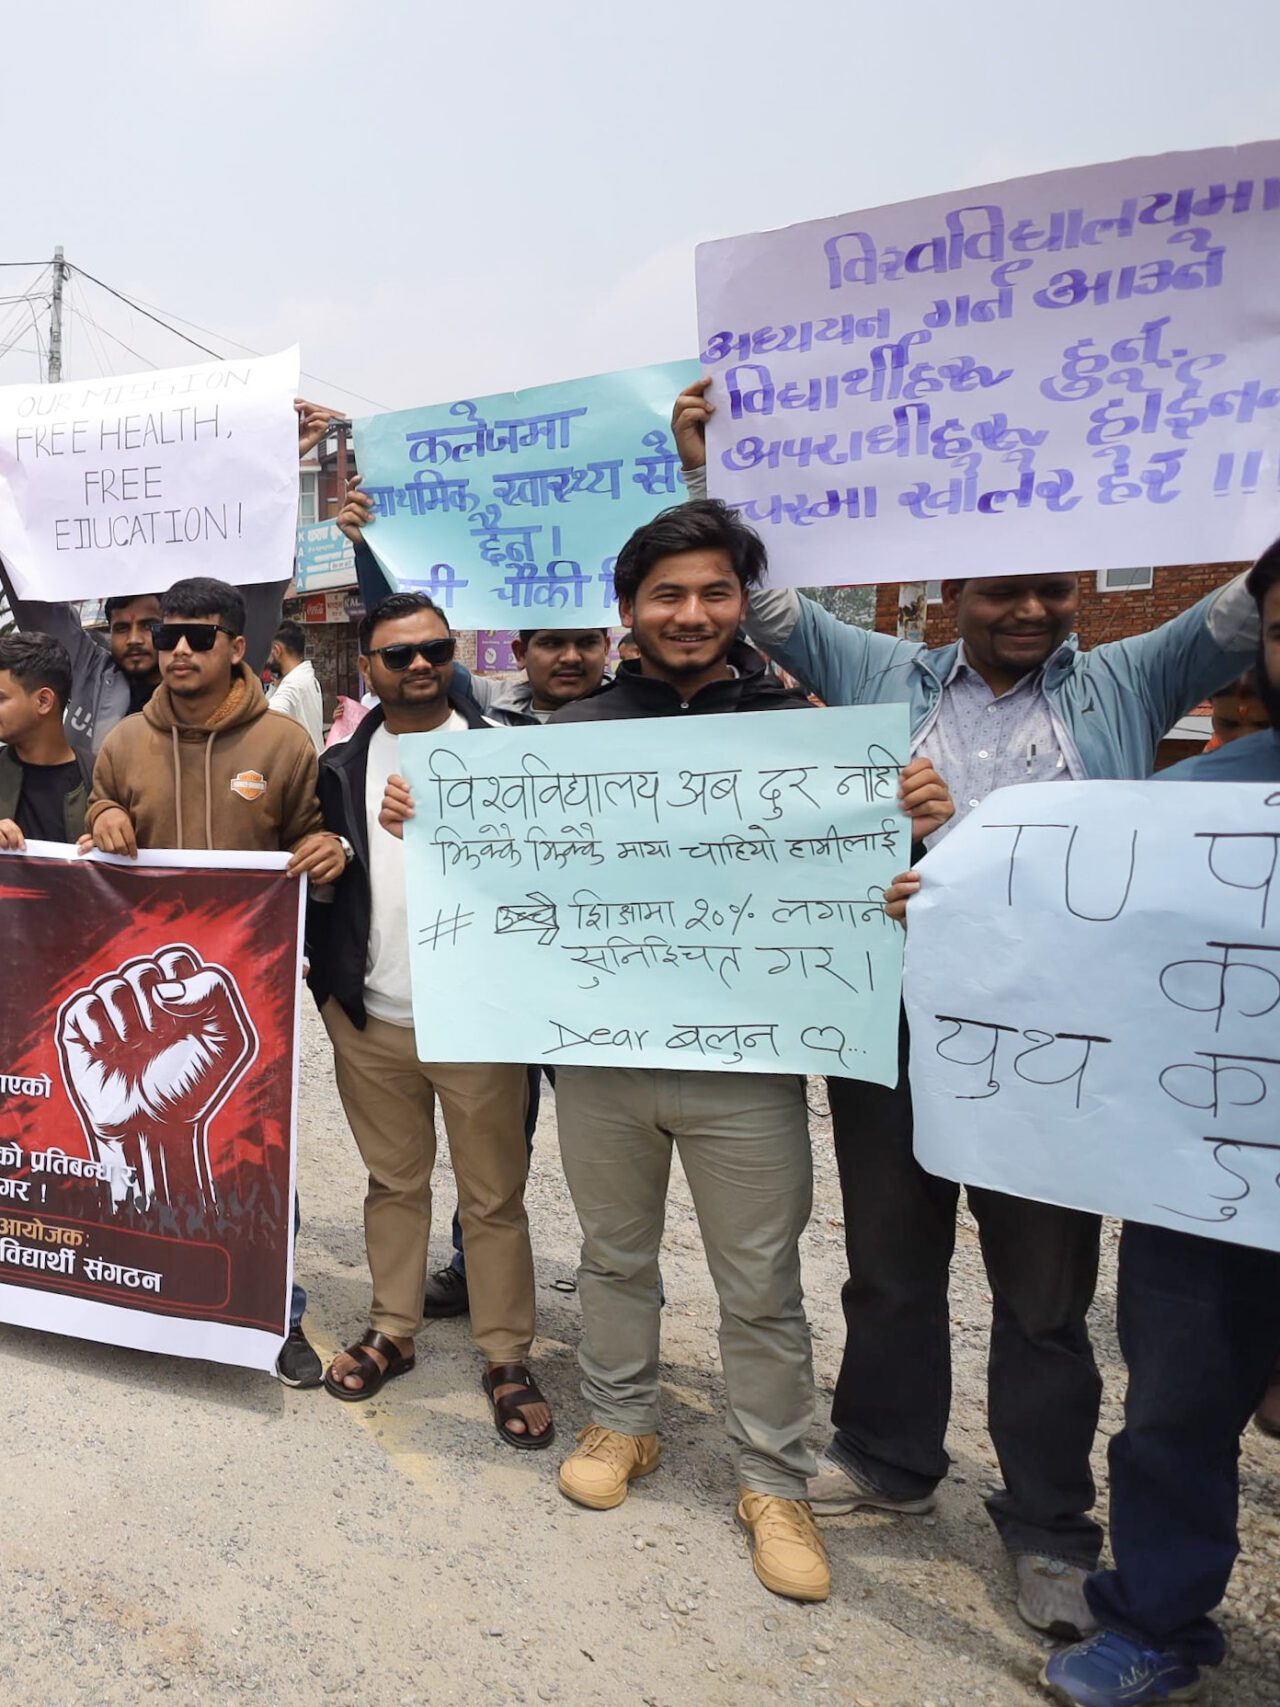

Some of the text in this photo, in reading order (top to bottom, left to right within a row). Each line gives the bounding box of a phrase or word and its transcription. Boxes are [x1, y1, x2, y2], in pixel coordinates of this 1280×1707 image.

[17, 369, 251, 417] OUR MISSION
[16, 404, 232, 462] FREE HEALTH,
[85, 466, 162, 505] FREE
[667, 769, 742, 821] अब
[616, 840, 671, 861] माया
[541, 1019, 650, 1055] Dear
[0, 1237, 76, 1274] विद्यार्थी
[83, 1257, 163, 1293] संगठन
